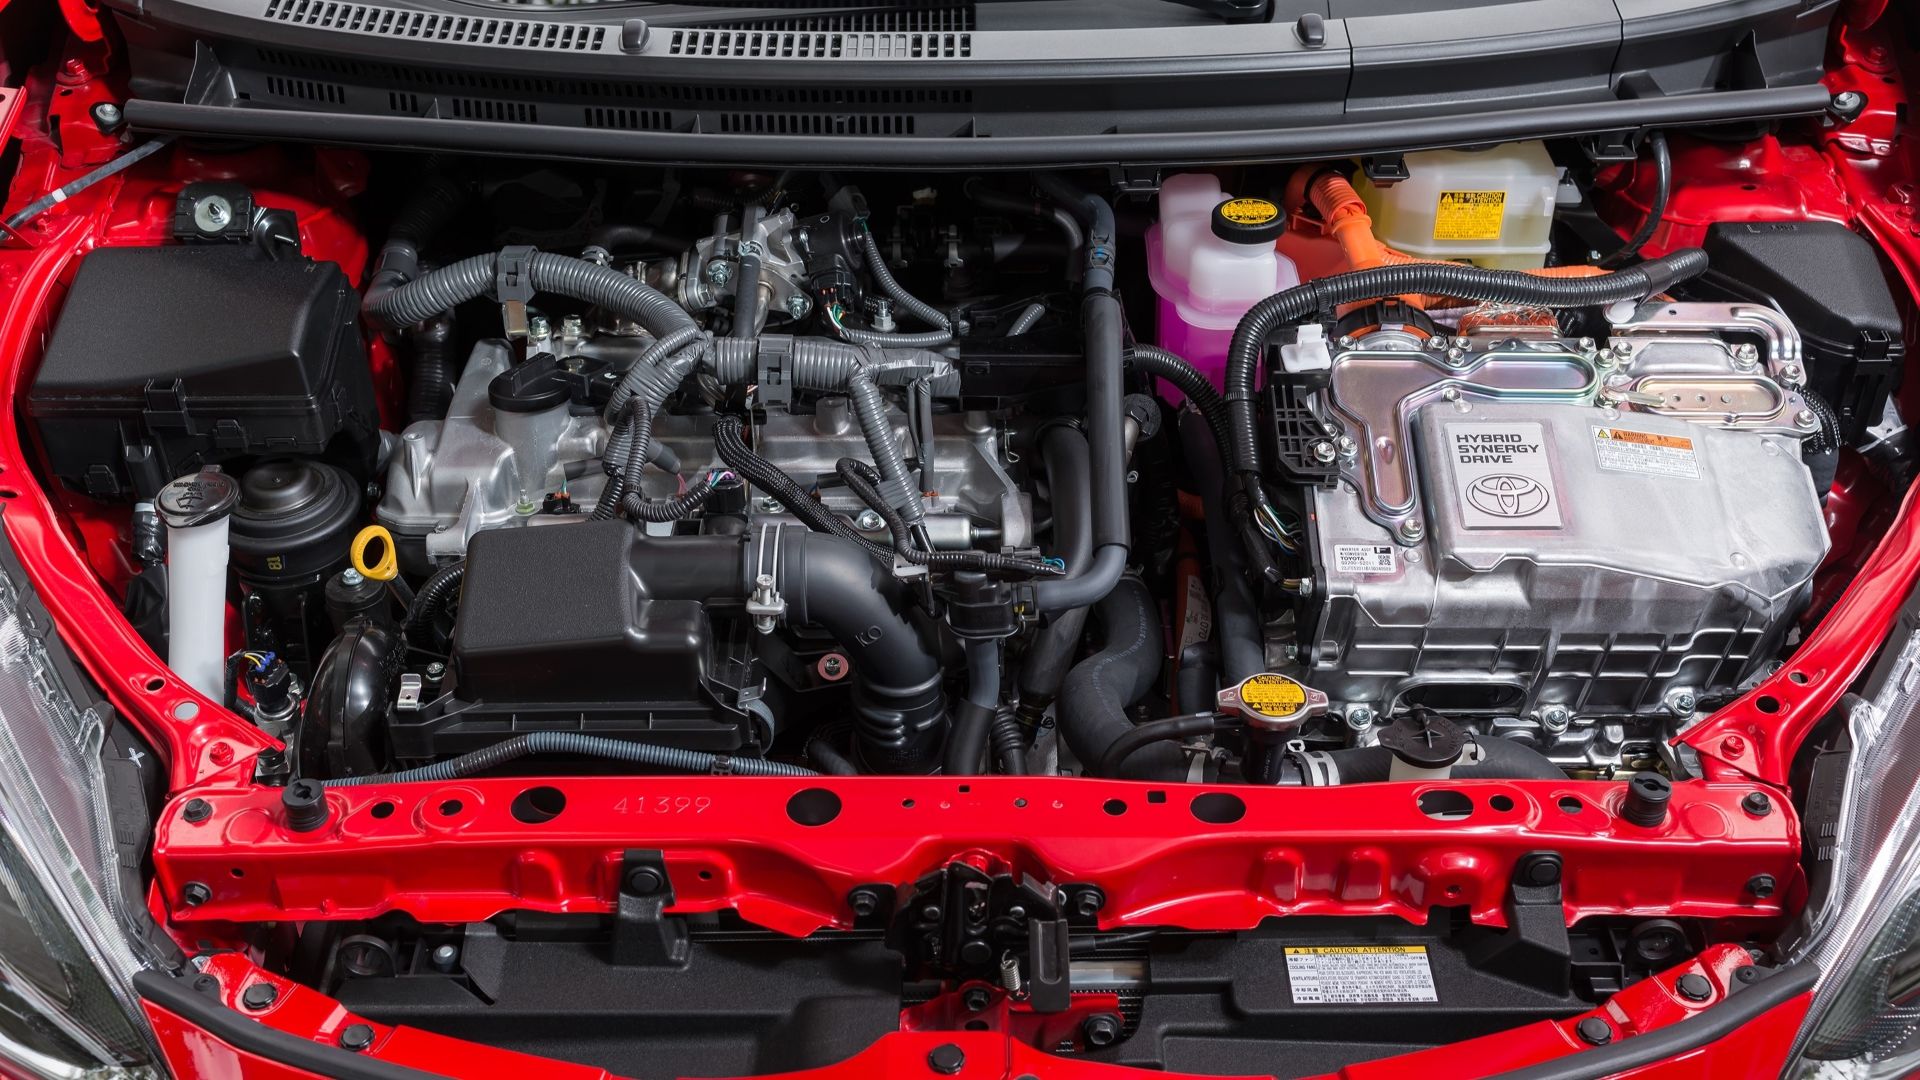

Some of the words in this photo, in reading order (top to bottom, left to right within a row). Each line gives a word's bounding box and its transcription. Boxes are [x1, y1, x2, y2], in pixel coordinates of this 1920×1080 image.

[1456, 434, 1522, 443] HYBRID
[1458, 444, 1539, 453] SYNERGY
[1460, 455, 1513, 463] DRIVE
[613, 796, 711, 814] 41399
